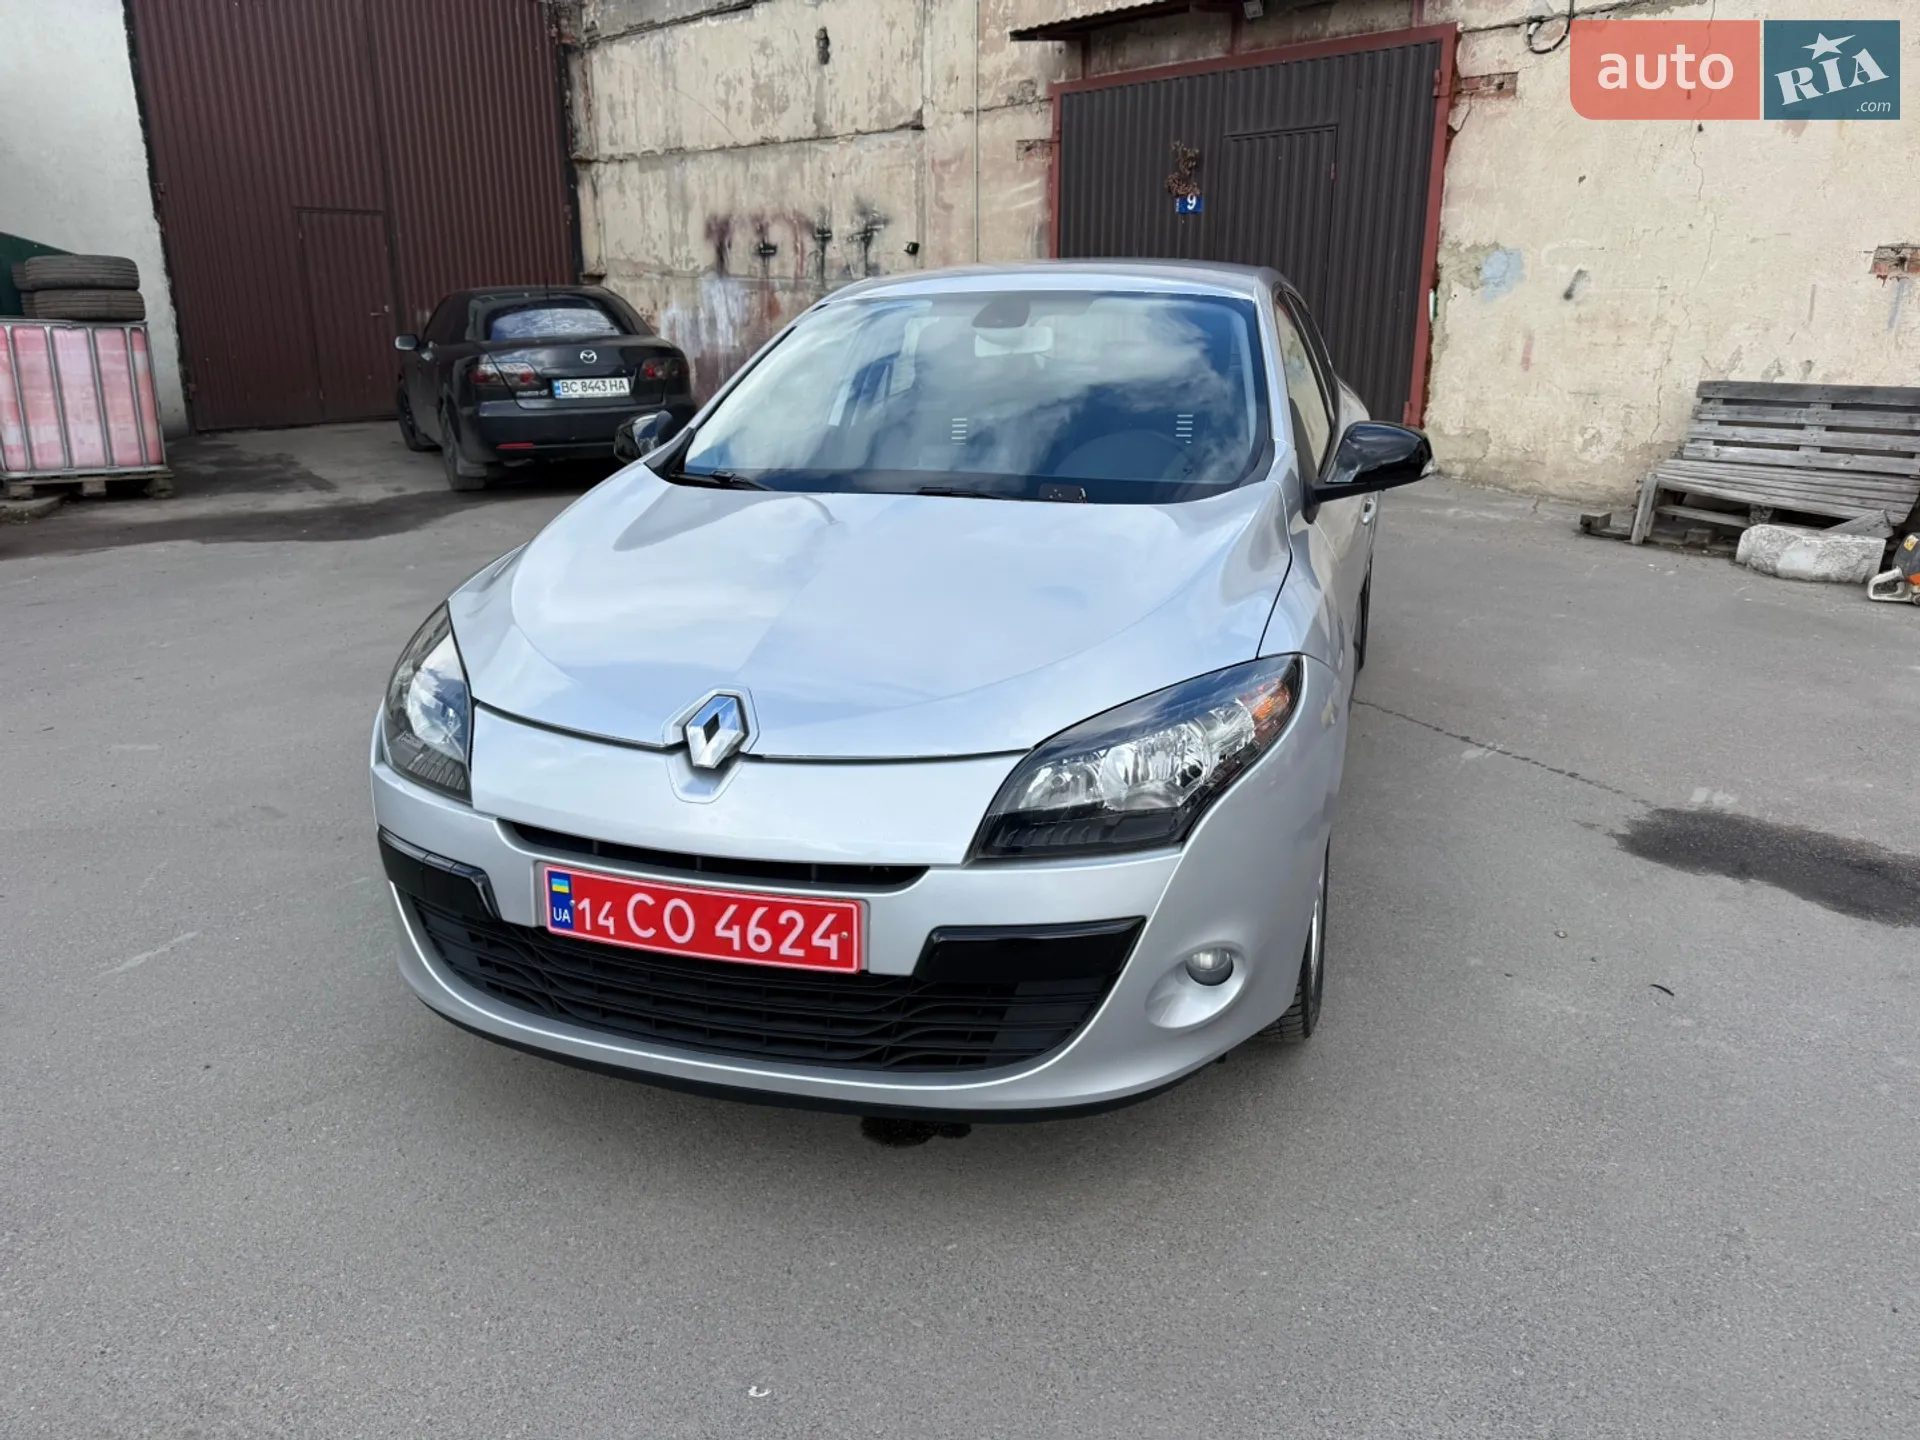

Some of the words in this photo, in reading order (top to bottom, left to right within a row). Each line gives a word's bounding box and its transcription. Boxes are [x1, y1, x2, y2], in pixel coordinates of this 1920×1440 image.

[1186, 193, 1197, 210] 9
[561, 381, 578, 393] BC
[580, 380, 608, 392] 8443
[609, 378, 627, 390] HA
[552, 906, 571, 924] UA
[577, 897, 616, 936] 14
[626, 892, 696, 945] CO
[714, 903, 839, 961] 4624
